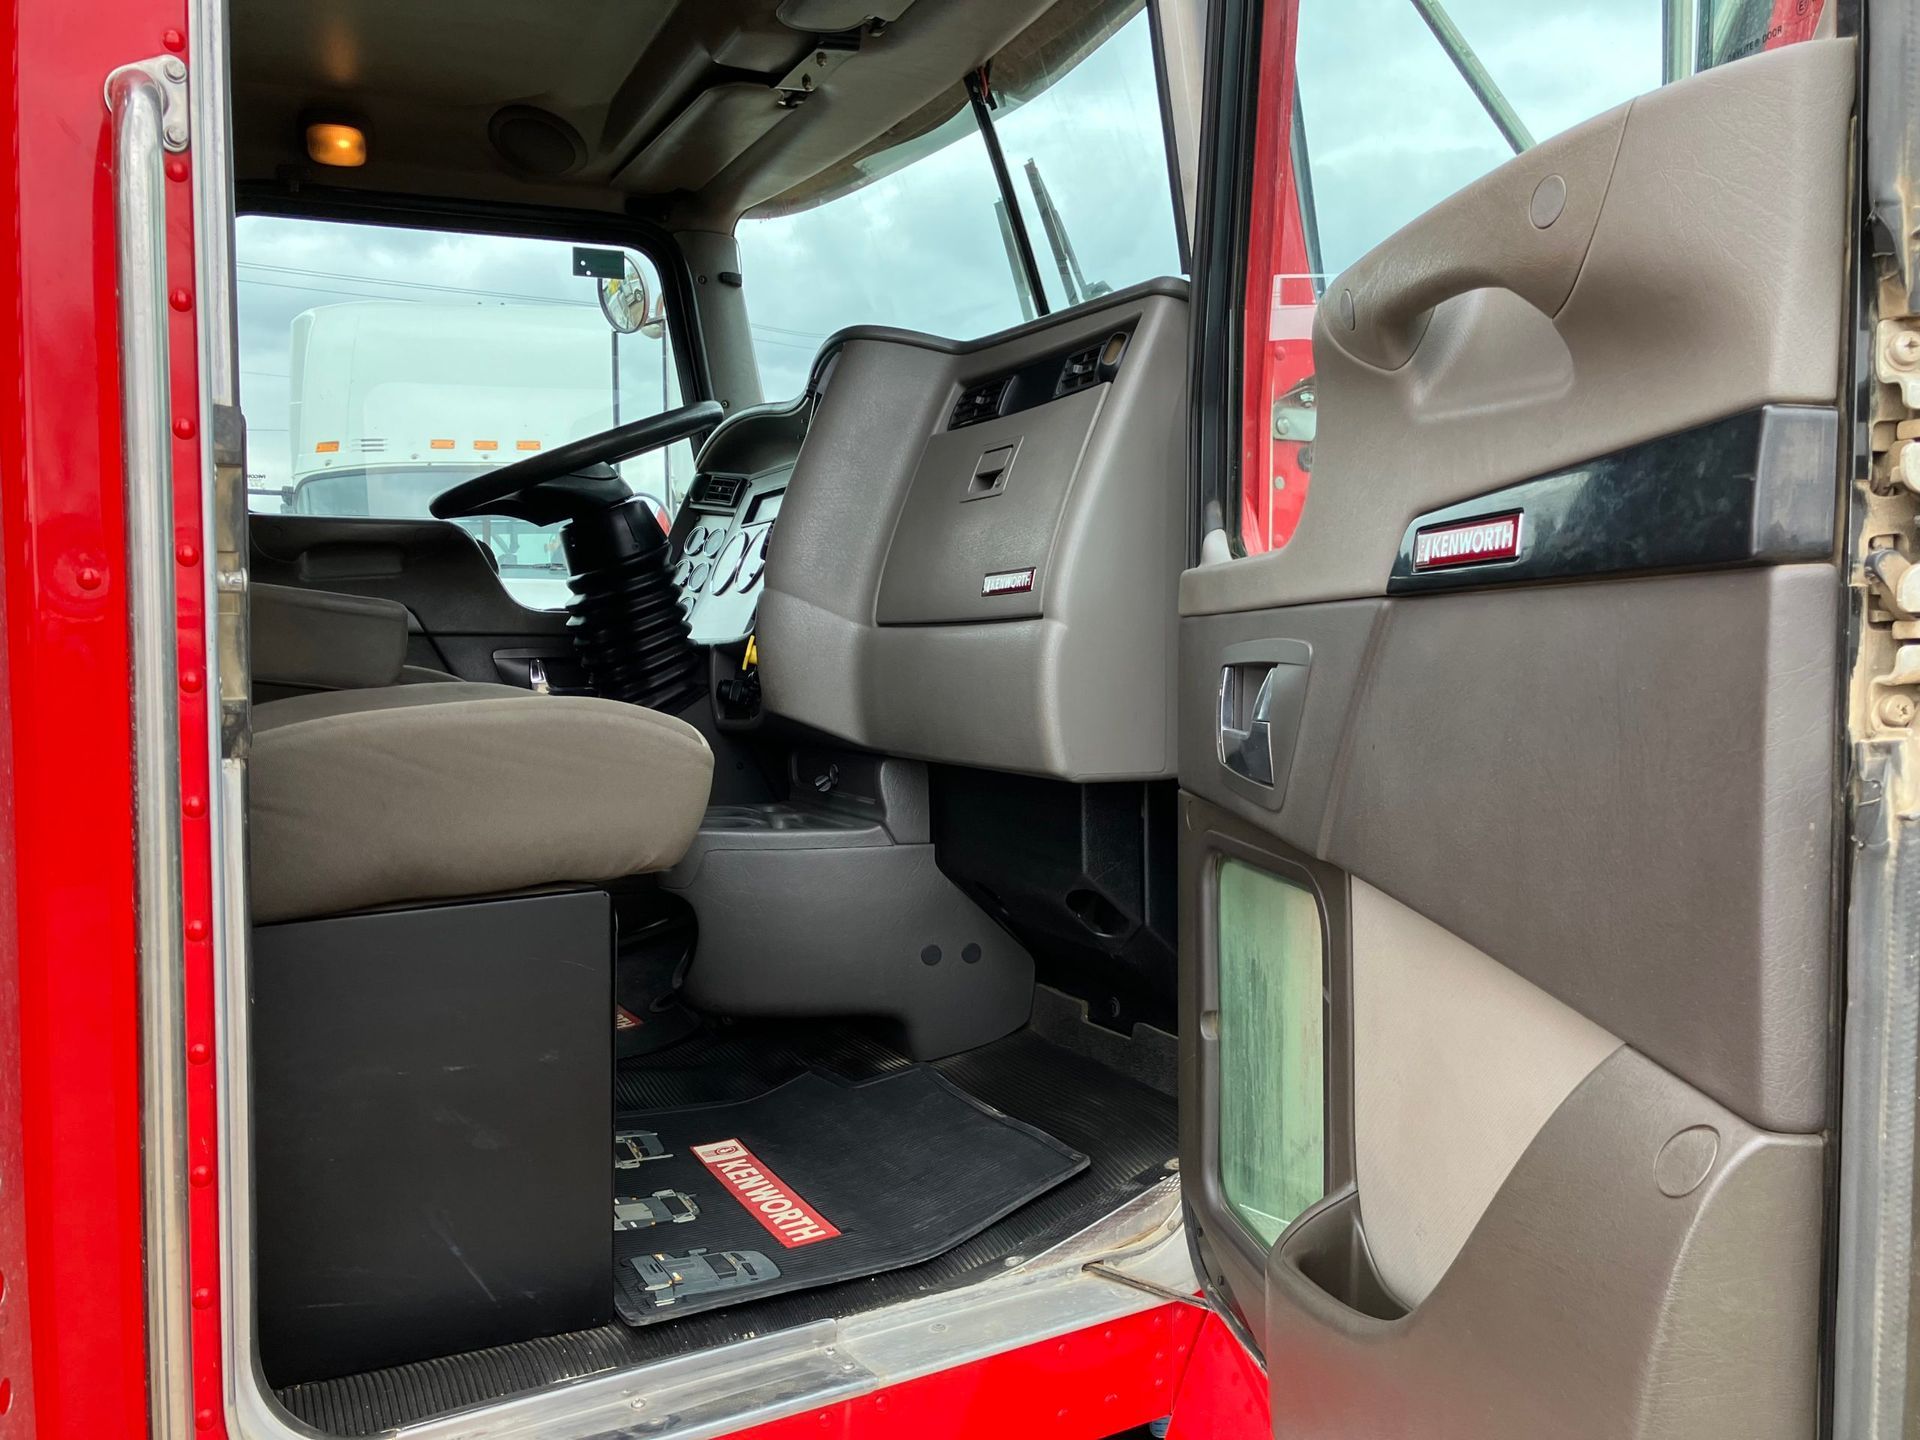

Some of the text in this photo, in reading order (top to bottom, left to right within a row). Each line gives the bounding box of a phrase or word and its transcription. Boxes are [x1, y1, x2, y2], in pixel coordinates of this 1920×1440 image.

[1431, 522, 1514, 559] KENWORTH
[989, 573, 1031, 590] KENWORTH
[716, 1158, 827, 1242] KENWORTH
